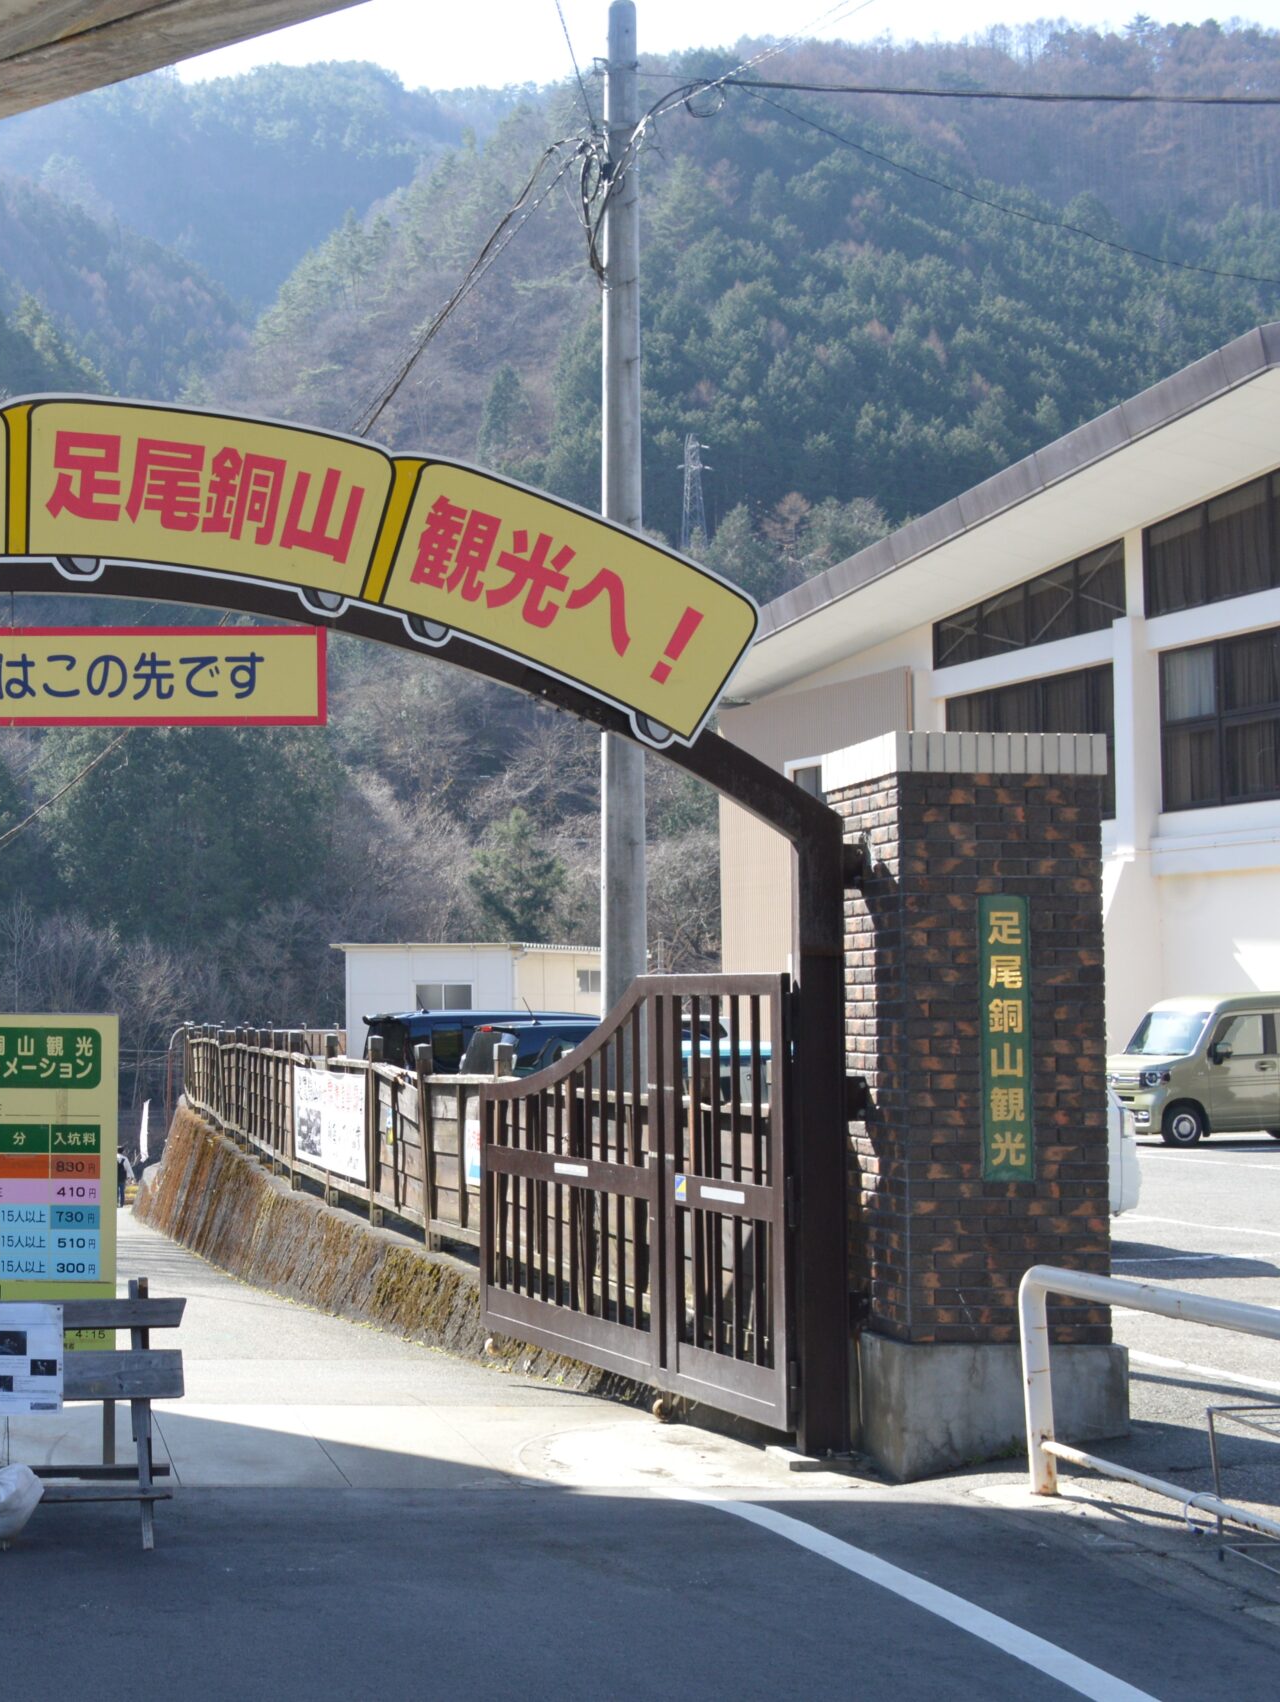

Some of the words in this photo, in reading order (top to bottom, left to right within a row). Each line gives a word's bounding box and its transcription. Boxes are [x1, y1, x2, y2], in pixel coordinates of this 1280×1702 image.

[45, 430, 366, 565] 足尾銅山
[409, 494, 705, 686] 観光へ！
[988, 911, 1027, 1167] 足尾銅山観光
[53, 1132, 96, 1146] 入坑料
[1, 1210, 46, 1223] 15人以上
[1, 1235, 46, 1249] 15人以上
[1, 1260, 46, 1273] 15人以上
